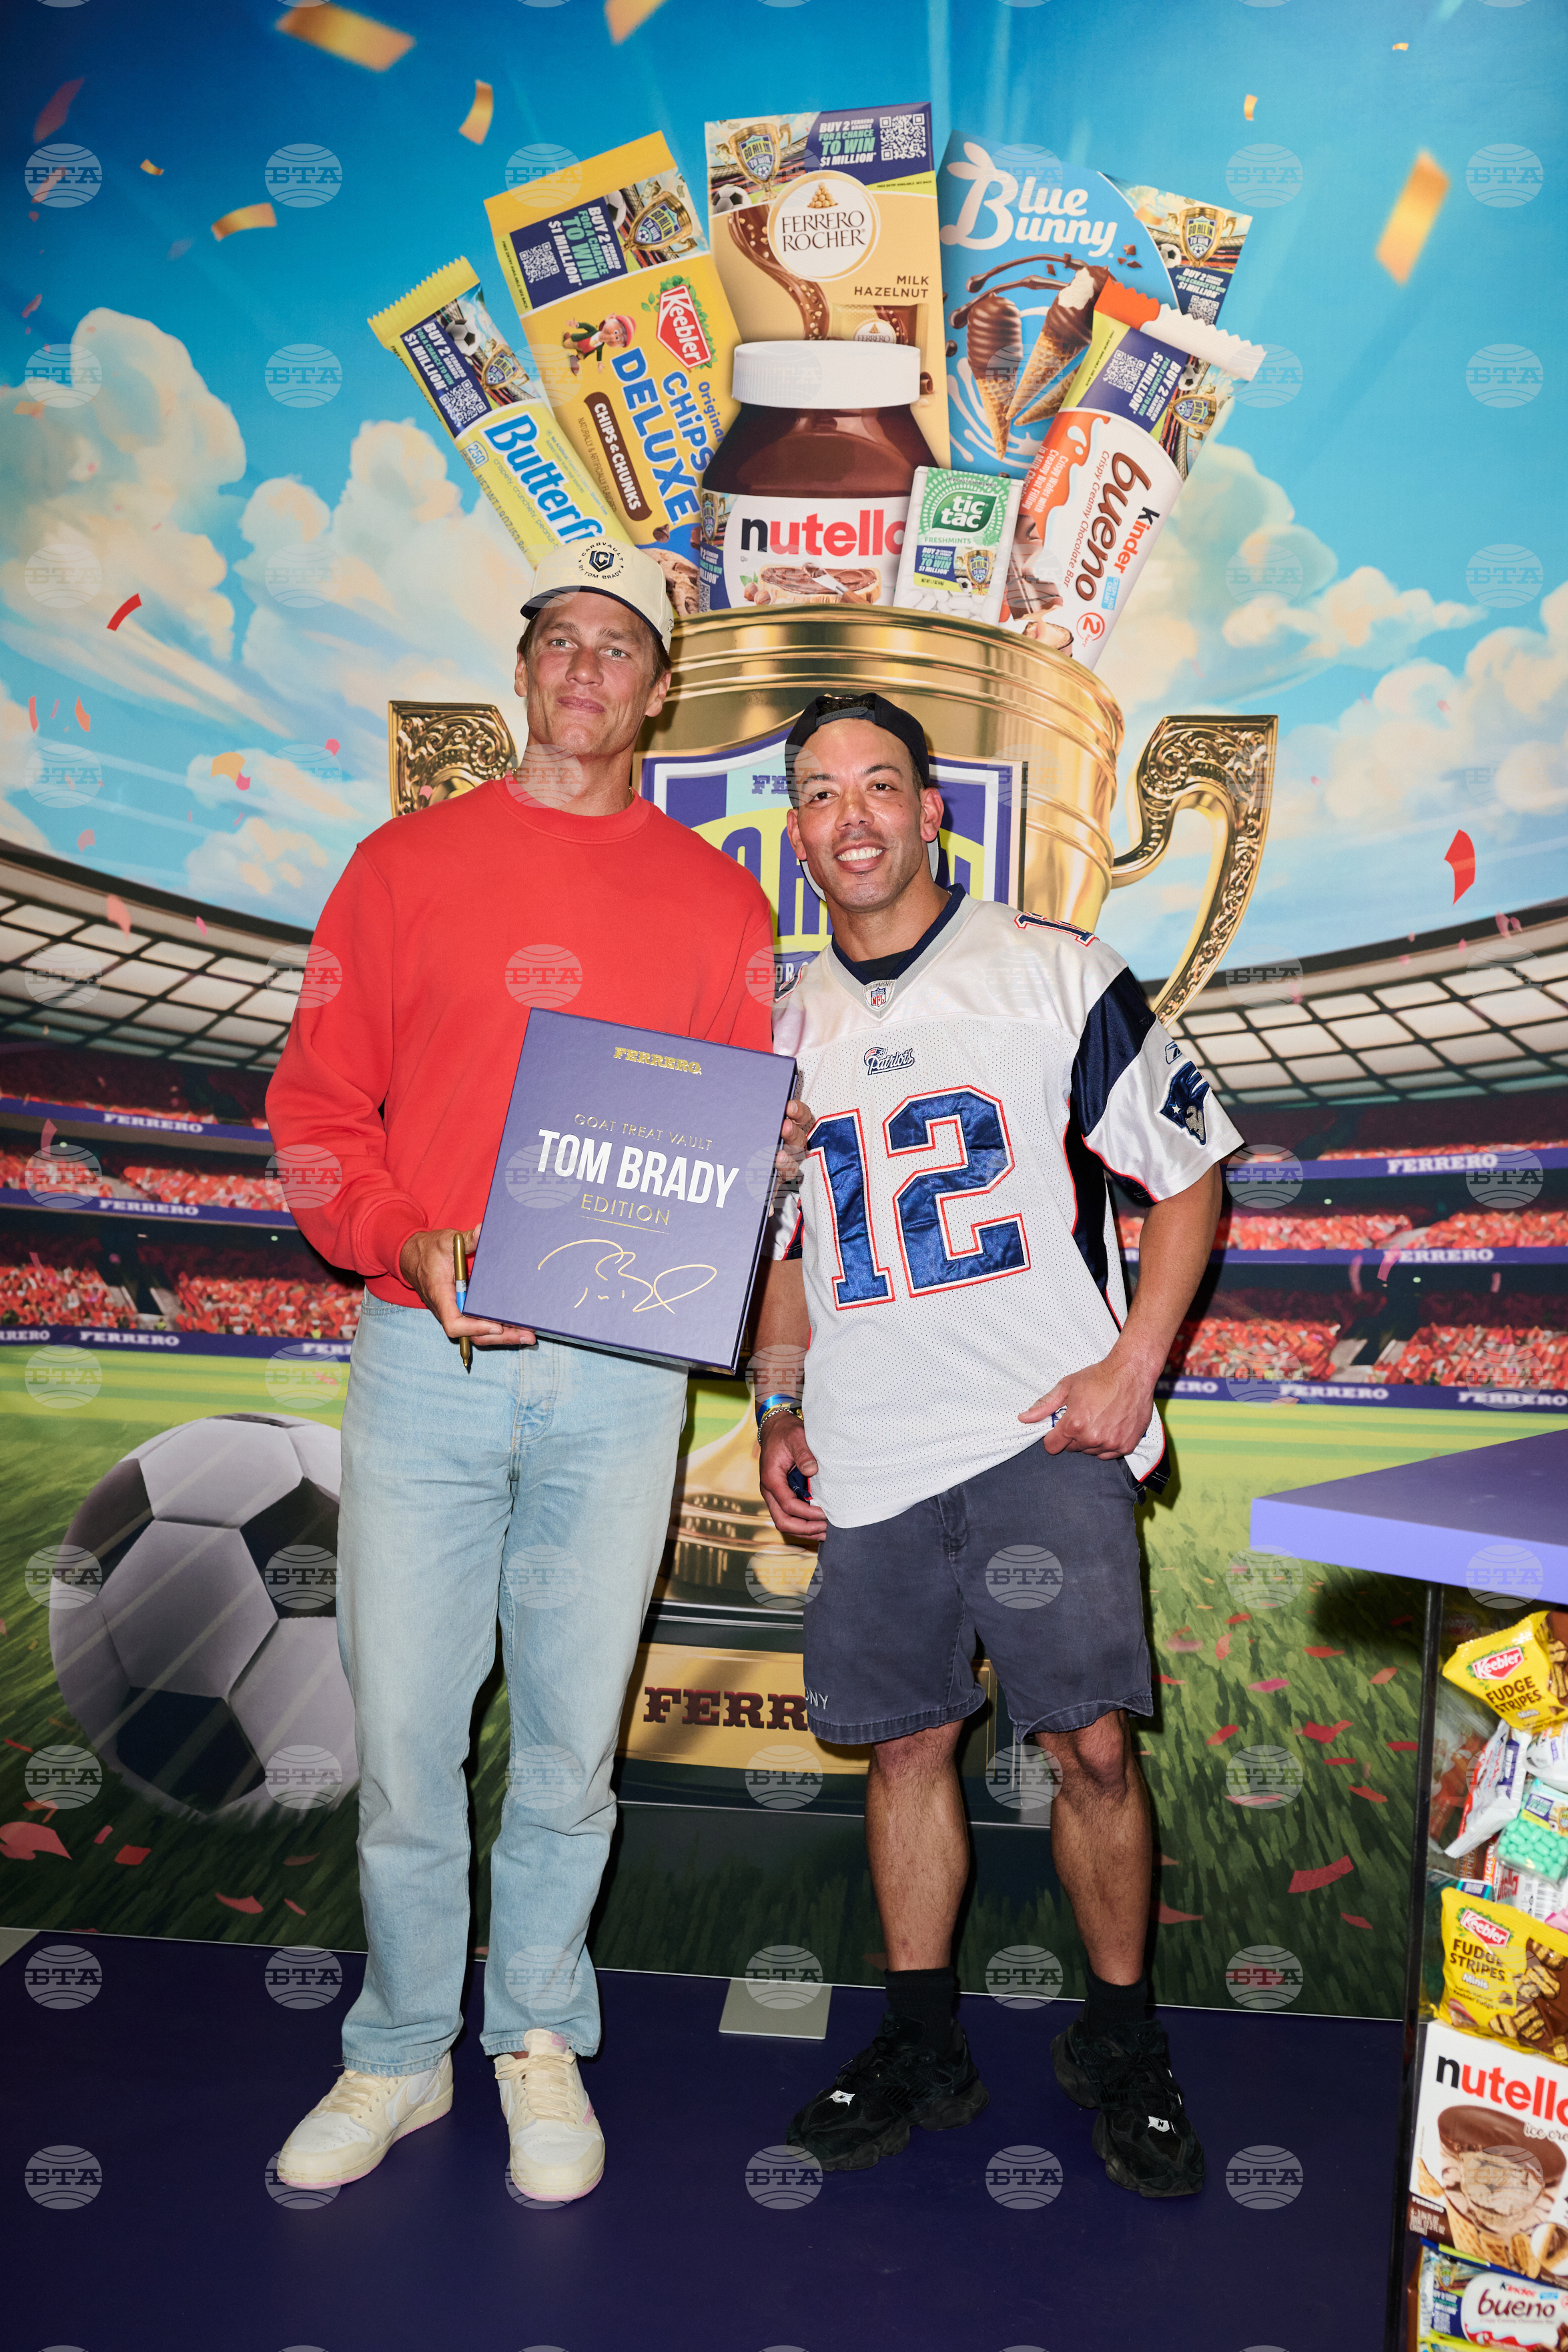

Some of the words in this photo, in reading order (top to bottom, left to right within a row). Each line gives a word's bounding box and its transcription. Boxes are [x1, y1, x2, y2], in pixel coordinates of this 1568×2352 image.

[819, 121, 842, 133] BUY
[842, 121, 850, 131] 2
[819, 133, 835, 141] FOR
[835, 132, 841, 141] A
[842, 129, 874, 139] CHANCE
[744, 147, 753, 159] GO
[821, 140, 841, 155] TO
[844, 137, 875, 153] WIN
[819, 156, 831, 167] $1
[588, 206, 605, 232] BUY
[598, 234, 611, 243] 2
[651, 210, 664, 220] GO
[659, 217, 671, 228] ALL
[781, 210, 865, 234] FERRERO
[548, 220, 563, 234] $1
[562, 216, 585, 240] TO
[650, 227, 661, 241] WIN
[663, 228, 673, 238] IN
[1188, 226, 1196, 235] GO
[1197, 224, 1206, 234] ALL
[578, 210, 593, 228] FOR
[588, 237, 610, 275] CHANCE
[1190, 237, 1197, 245] TO
[571, 243, 600, 280] WIN
[897, 275, 929, 286] MILK
[1182, 268, 1202, 279] BUY
[1201, 272, 1207, 281] 2
[855, 286, 928, 298] HAZELNUT
[415, 328, 426, 342] FOR
[662, 292, 702, 360] Keebler
[404, 334, 420, 347] $1
[857, 334, 891, 342] FERRERO
[423, 322, 447, 346] BUY
[438, 346, 451, 356] 2
[448, 354, 466, 378] FERRERO
[426, 344, 442, 367] CHANCE
[1151, 352, 1163, 367] $1
[439, 365, 448, 374] TO
[443, 357, 461, 379] BRANDS
[1161, 357, 1170, 368] FOR
[443, 372, 454, 386] WIN
[1148, 374, 1162, 398] CHANCE
[1163, 361, 1182, 390] BUY
[1144, 396, 1152, 404] TO
[1158, 386, 1169, 397] 2
[698, 381, 725, 442] Original
[1138, 404, 1146, 416] WIN
[1150, 396, 1166, 422] FERRERO
[594, 402, 618, 444] CHIPS
[611, 347, 701, 523] DELUXE
[468, 443, 486, 465] 250
[578, 417, 593, 446] NATURALLY
[591, 453, 607, 484] ARTIFICIALLY
[610, 444, 620, 453] &
[1039, 446, 1048, 454] in
[1043, 449, 1059, 477] Creamy
[1054, 455, 1069, 481] Crispy
[1094, 451, 1110, 480] Crispy
[484, 414, 603, 544] Butterf
[613, 453, 641, 510] CHUNKS
[1035, 474, 1047, 490] Nut
[1022, 486, 1040, 510] Filling
[1044, 479, 1058, 501] Wafer
[1083, 482, 1100, 519] Creamy
[953, 495, 986, 516] tic
[1034, 498, 1048, 514] with
[941, 508, 982, 528] tac
[1076, 452, 1152, 601] bueno
[581, 542, 623, 562] CARDVAULT
[1069, 520, 1089, 568] Chocolate
[921, 558, 933, 566] TO
[933, 559, 951, 569] WIN
[584, 571, 599, 579] TOM
[602, 569, 622, 580] BRADY
[1064, 570, 1074, 588] Bar
[1083, 617, 1101, 635] 2
[872, 996, 885, 1006] NFL
[613, 1046, 703, 1075] FERRERO
[867, 1048, 913, 1075] Patriots
[104, 1112, 204, 1133] FERRERO
[574, 1113, 616, 1132] GOAT
[623, 1122, 663, 1141] TREAT
[669, 1132, 713, 1151] VAULT
[537, 1128, 613, 1184] TOM
[617, 1146, 739, 1208] BRADY
[1387, 1153, 1499, 1174] FERRERO
[99, 1199, 200, 1216] FERRERO
[805, 1085, 1031, 1310] 12
[580, 1194, 671, 1226] EDITION
[81, 1331, 179, 1346] FERRERO
[1474, 1652, 1520, 1678] Keebler
[1485, 1676, 1535, 1704] FUDGE
[1495, 1689, 1543, 1713] STRIPES
[1517, 1709, 1540, 1720] Minis
[1464, 1911, 1508, 1944] Keebler
[1453, 1938, 1503, 1967] FUDGE
[1450, 1952, 1507, 1982] STRIPES
[1462, 1973, 1489, 1990] Minis
[1478, 2289, 1556, 2317] bueno
